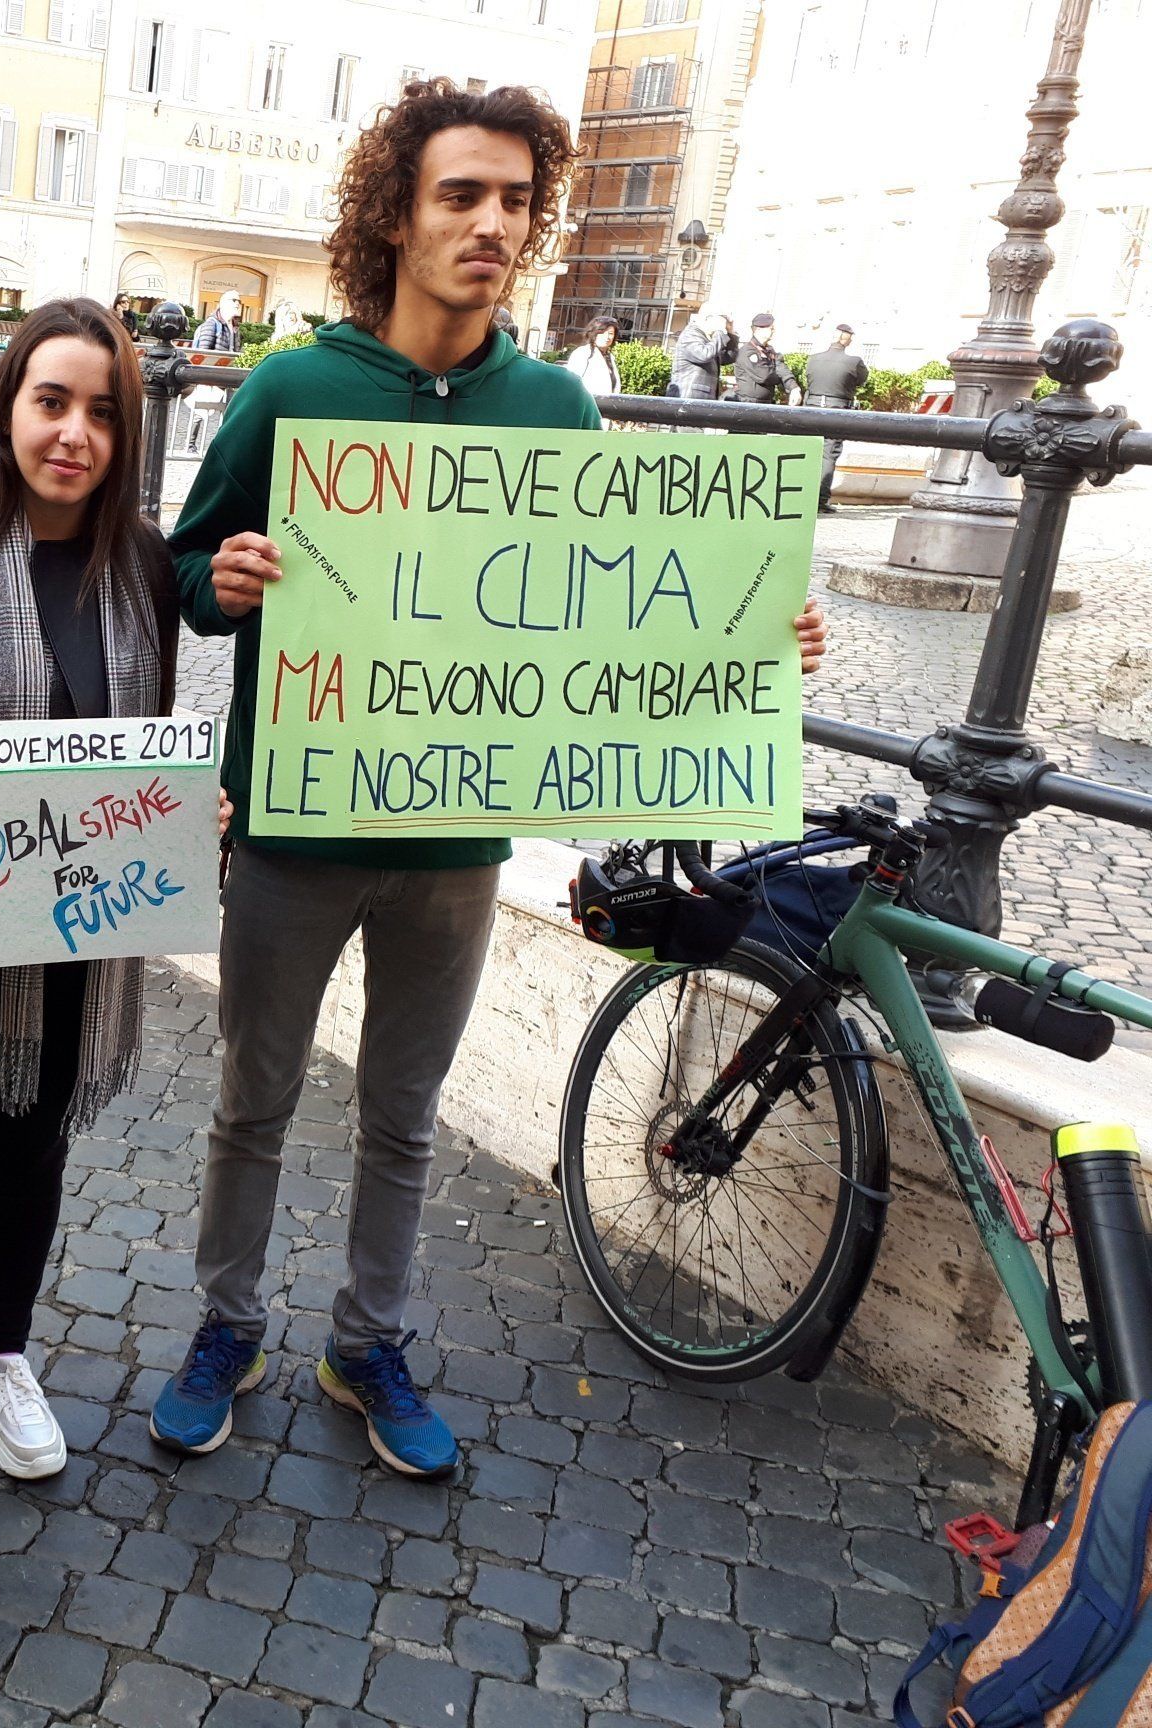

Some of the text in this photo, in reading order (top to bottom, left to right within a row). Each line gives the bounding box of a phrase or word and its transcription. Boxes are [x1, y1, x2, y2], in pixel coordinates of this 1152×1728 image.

[184, 122, 319, 163] ALBERGO
[290, 438, 806, 520] NON DEVE CAMBIARE
[393, 542, 699, 631] IL CLIMA
[272, 649, 781, 724] MA DEVONO CAMBIARE
[139, 720, 213, 760] 2019
[266, 742, 775, 816] LE NOSTRE ABITUDINI
[52, 860, 185, 954] FUTURE
[53, 863, 99, 896] FOR
[915, 1062, 994, 1228] COYOTE
